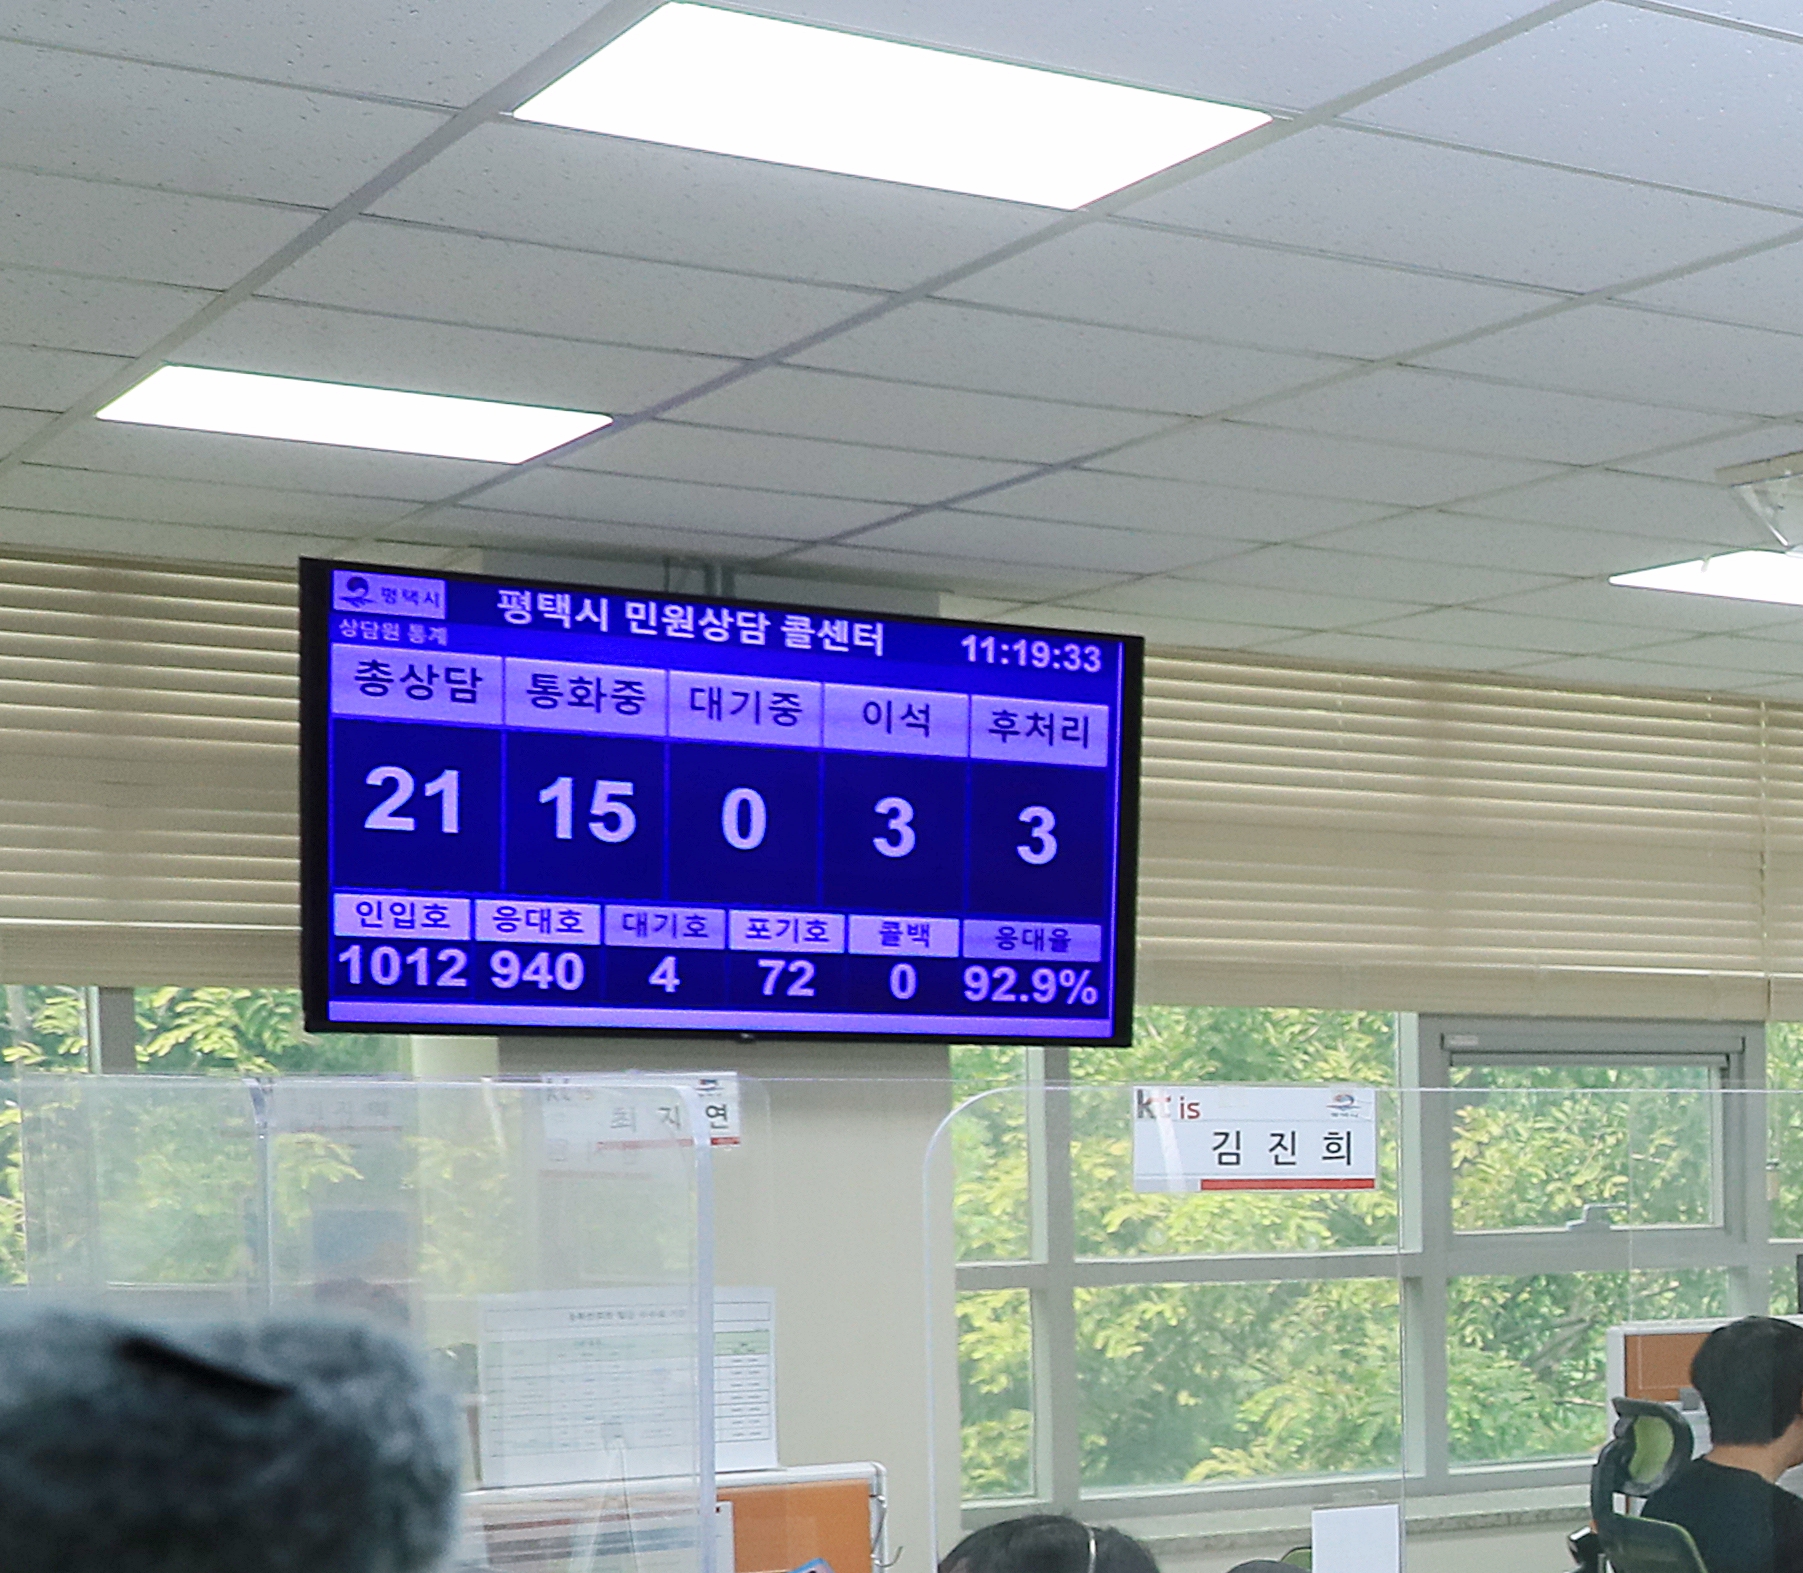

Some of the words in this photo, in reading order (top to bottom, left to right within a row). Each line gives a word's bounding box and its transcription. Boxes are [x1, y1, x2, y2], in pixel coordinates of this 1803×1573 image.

[338, 617, 399, 643] 상담원
[407, 622, 449, 647] 통계
[496, 588, 611, 634] 평택시
[625, 600, 771, 645] 민원상담
[780, 611, 885, 657] 콜센터
[961, 635, 1103, 674] 11:19:33
[353, 658, 483, 707] 총상담
[526, 672, 647, 718] 통화중
[689, 683, 805, 730] 대기중
[864, 698, 931, 739] 이석
[987, 707, 1091, 749] 후처리
[363, 764, 460, 835] 21
[538, 776, 637, 845] 15
[721, 786, 767, 852] 0
[873, 797, 917, 859] 3
[1016, 806, 1058, 866] 3
[355, 900, 452, 933] 인입호
[492, 904, 584, 938] 응대호
[622, 909, 710, 941] 대기호
[745, 915, 830, 946] 포기호
[878, 920, 933, 948] 콜백
[994, 925, 1073, 954] 응대율
[338, 944, 470, 988] 1012
[490, 950, 585, 991] 940
[648, 956, 680, 993] 4
[757, 958, 816, 998] 72
[890, 962, 917, 1001] 0
[963, 966, 1099, 1007] 92.9%
[1178, 1096, 1201, 1119] is
